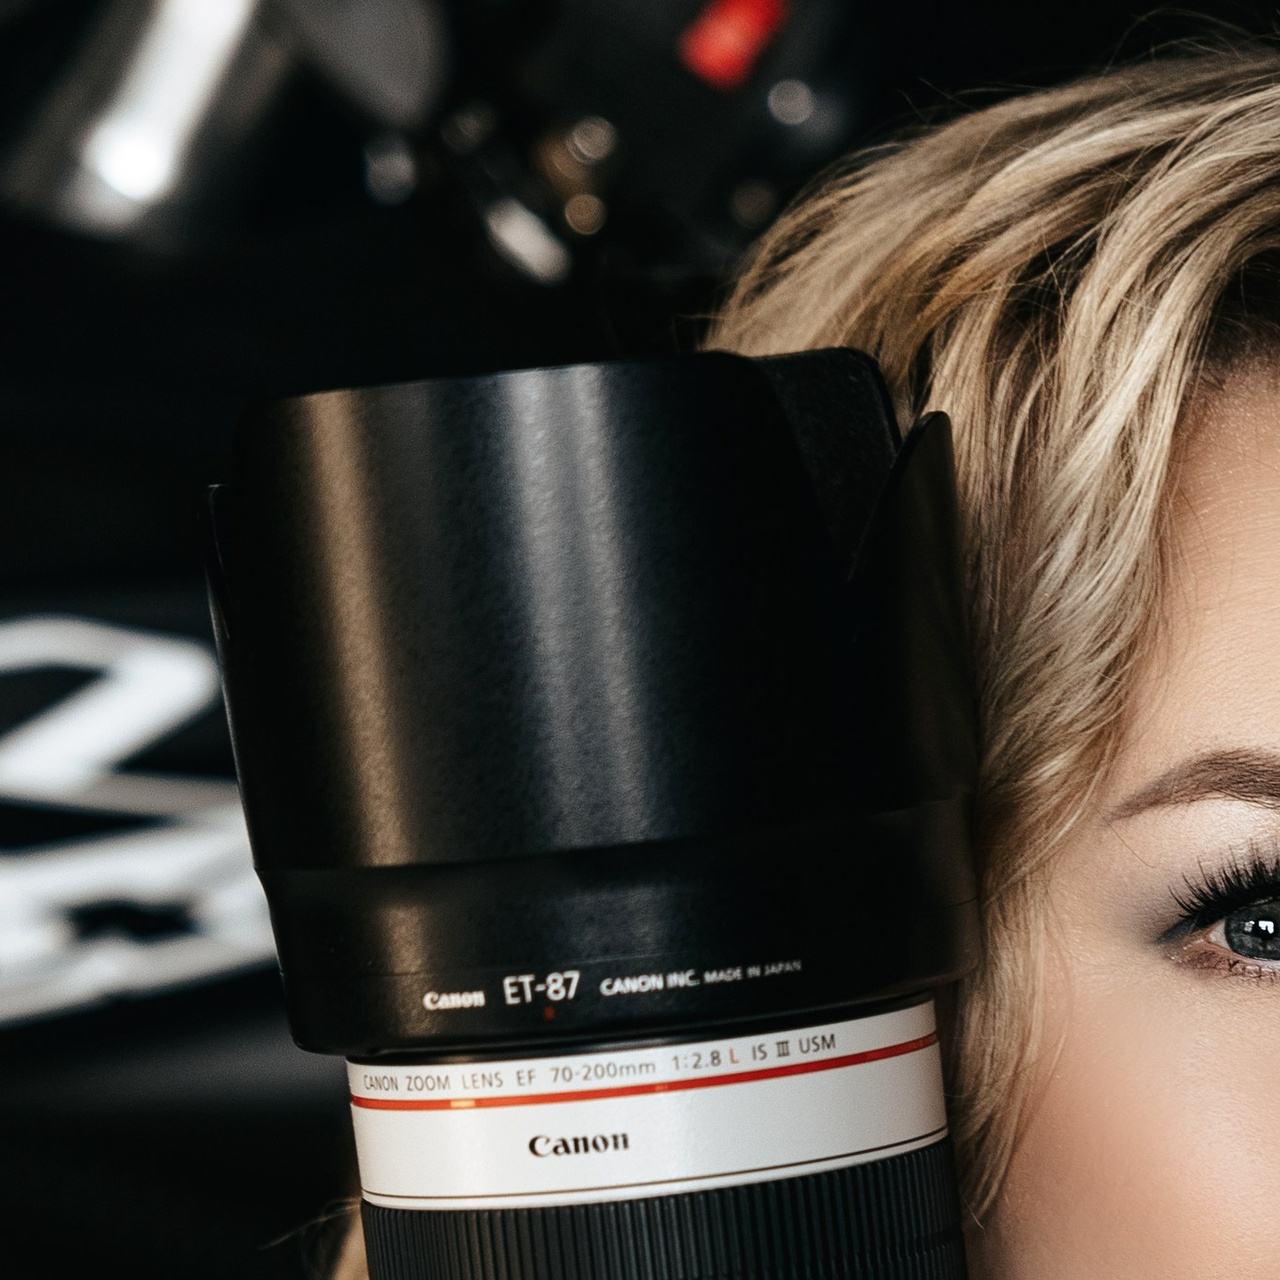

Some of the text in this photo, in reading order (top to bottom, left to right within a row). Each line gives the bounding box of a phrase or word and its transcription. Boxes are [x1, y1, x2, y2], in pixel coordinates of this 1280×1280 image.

[422, 990, 486, 1011] Canon
[503, 970, 581, 1005] ET-87
[599, 974, 664, 996] CANON
[703, 967, 743, 984] MADE
[747, 965, 761, 979] IN
[363, 1074, 399, 1092] CANON
[406, 1075, 451, 1092] ZOOM
[462, 1072, 504, 1090] LENS
[516, 1069, 537, 1087] EF
[550, 1061, 656, 1083] 70-200mm
[671, 1049, 722, 1070] 1:2.8
[729, 1047, 740, 1065] L
[752, 1044, 768, 1061] IS
[798, 1033, 837, 1055] USM
[528, 1132, 630, 1158] Canon
